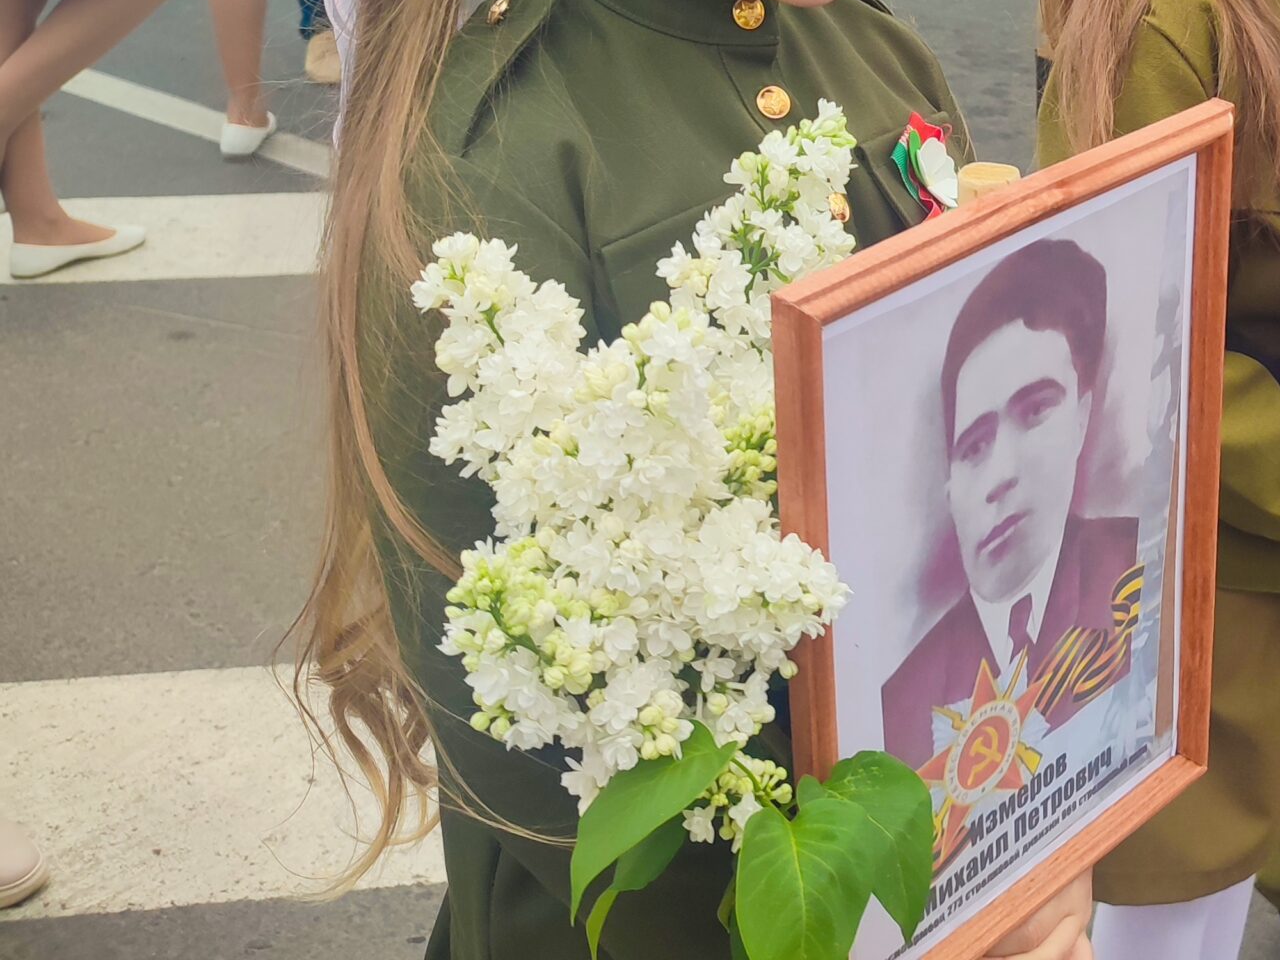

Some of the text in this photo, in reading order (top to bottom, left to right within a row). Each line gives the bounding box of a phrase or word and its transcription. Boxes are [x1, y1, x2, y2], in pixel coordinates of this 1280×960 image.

[922, 830, 1009, 920] Михаил
[1014, 746, 1112, 843] Петрович
[968, 752, 1068, 846] Измеров
[946, 898, 964, 918] 273
